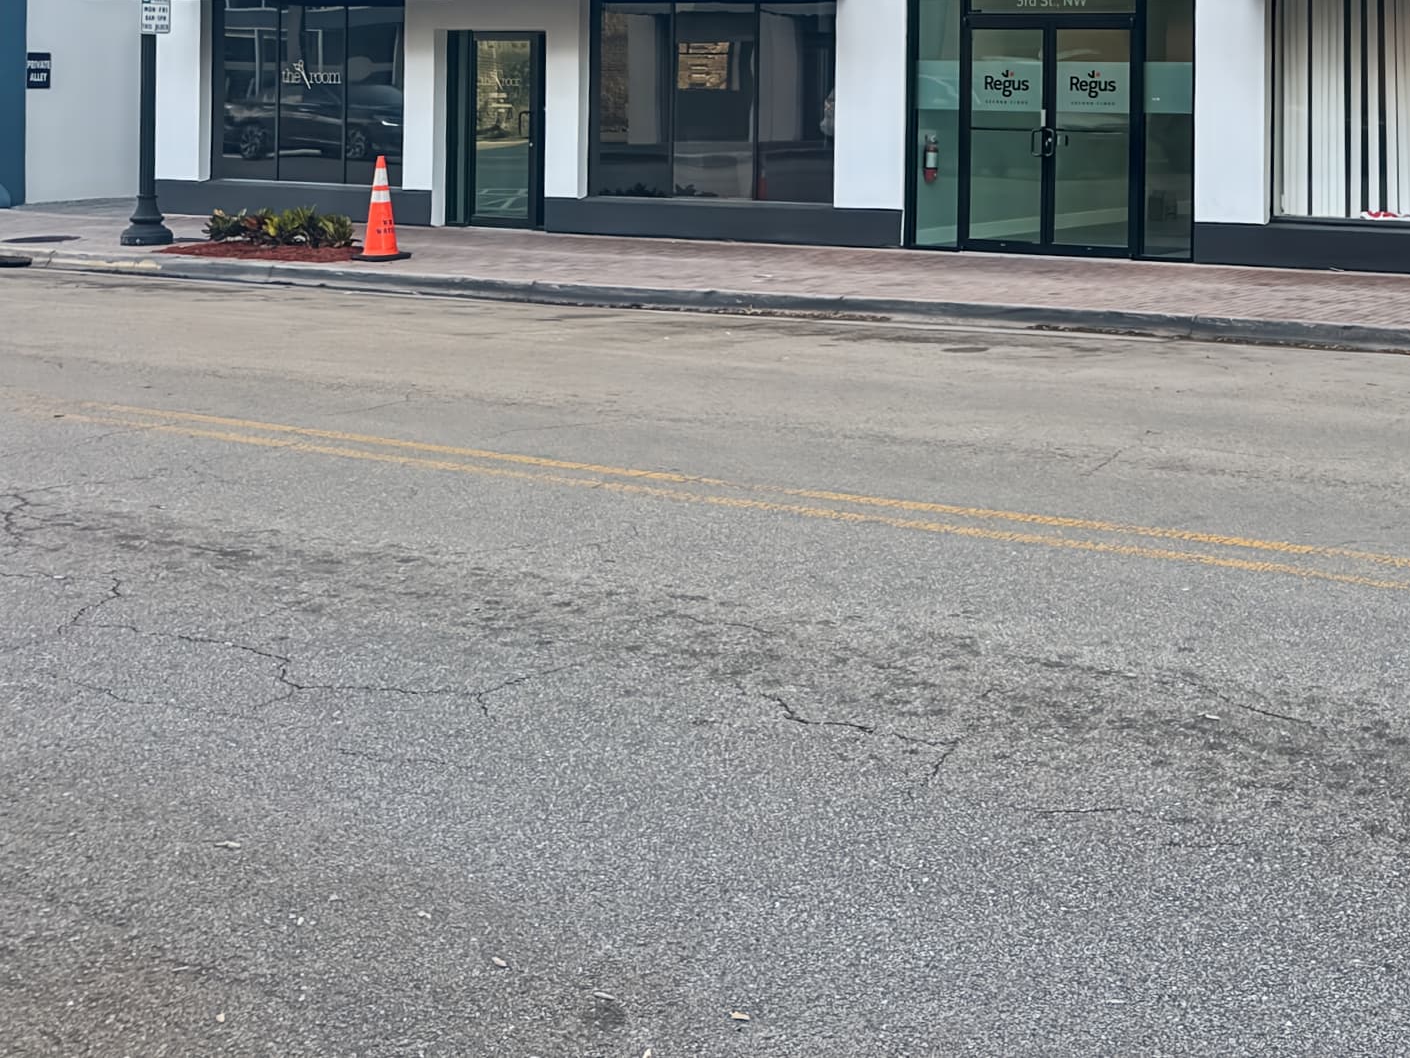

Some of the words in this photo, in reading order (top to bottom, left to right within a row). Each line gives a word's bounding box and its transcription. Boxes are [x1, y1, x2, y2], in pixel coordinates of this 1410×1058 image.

[29, 72, 48, 82] ALLEY
[281, 68, 301, 84] the
[309, 71, 342, 84] room
[984, 75, 1029, 97] Regus
[1070, 76, 1116, 98] Regus
